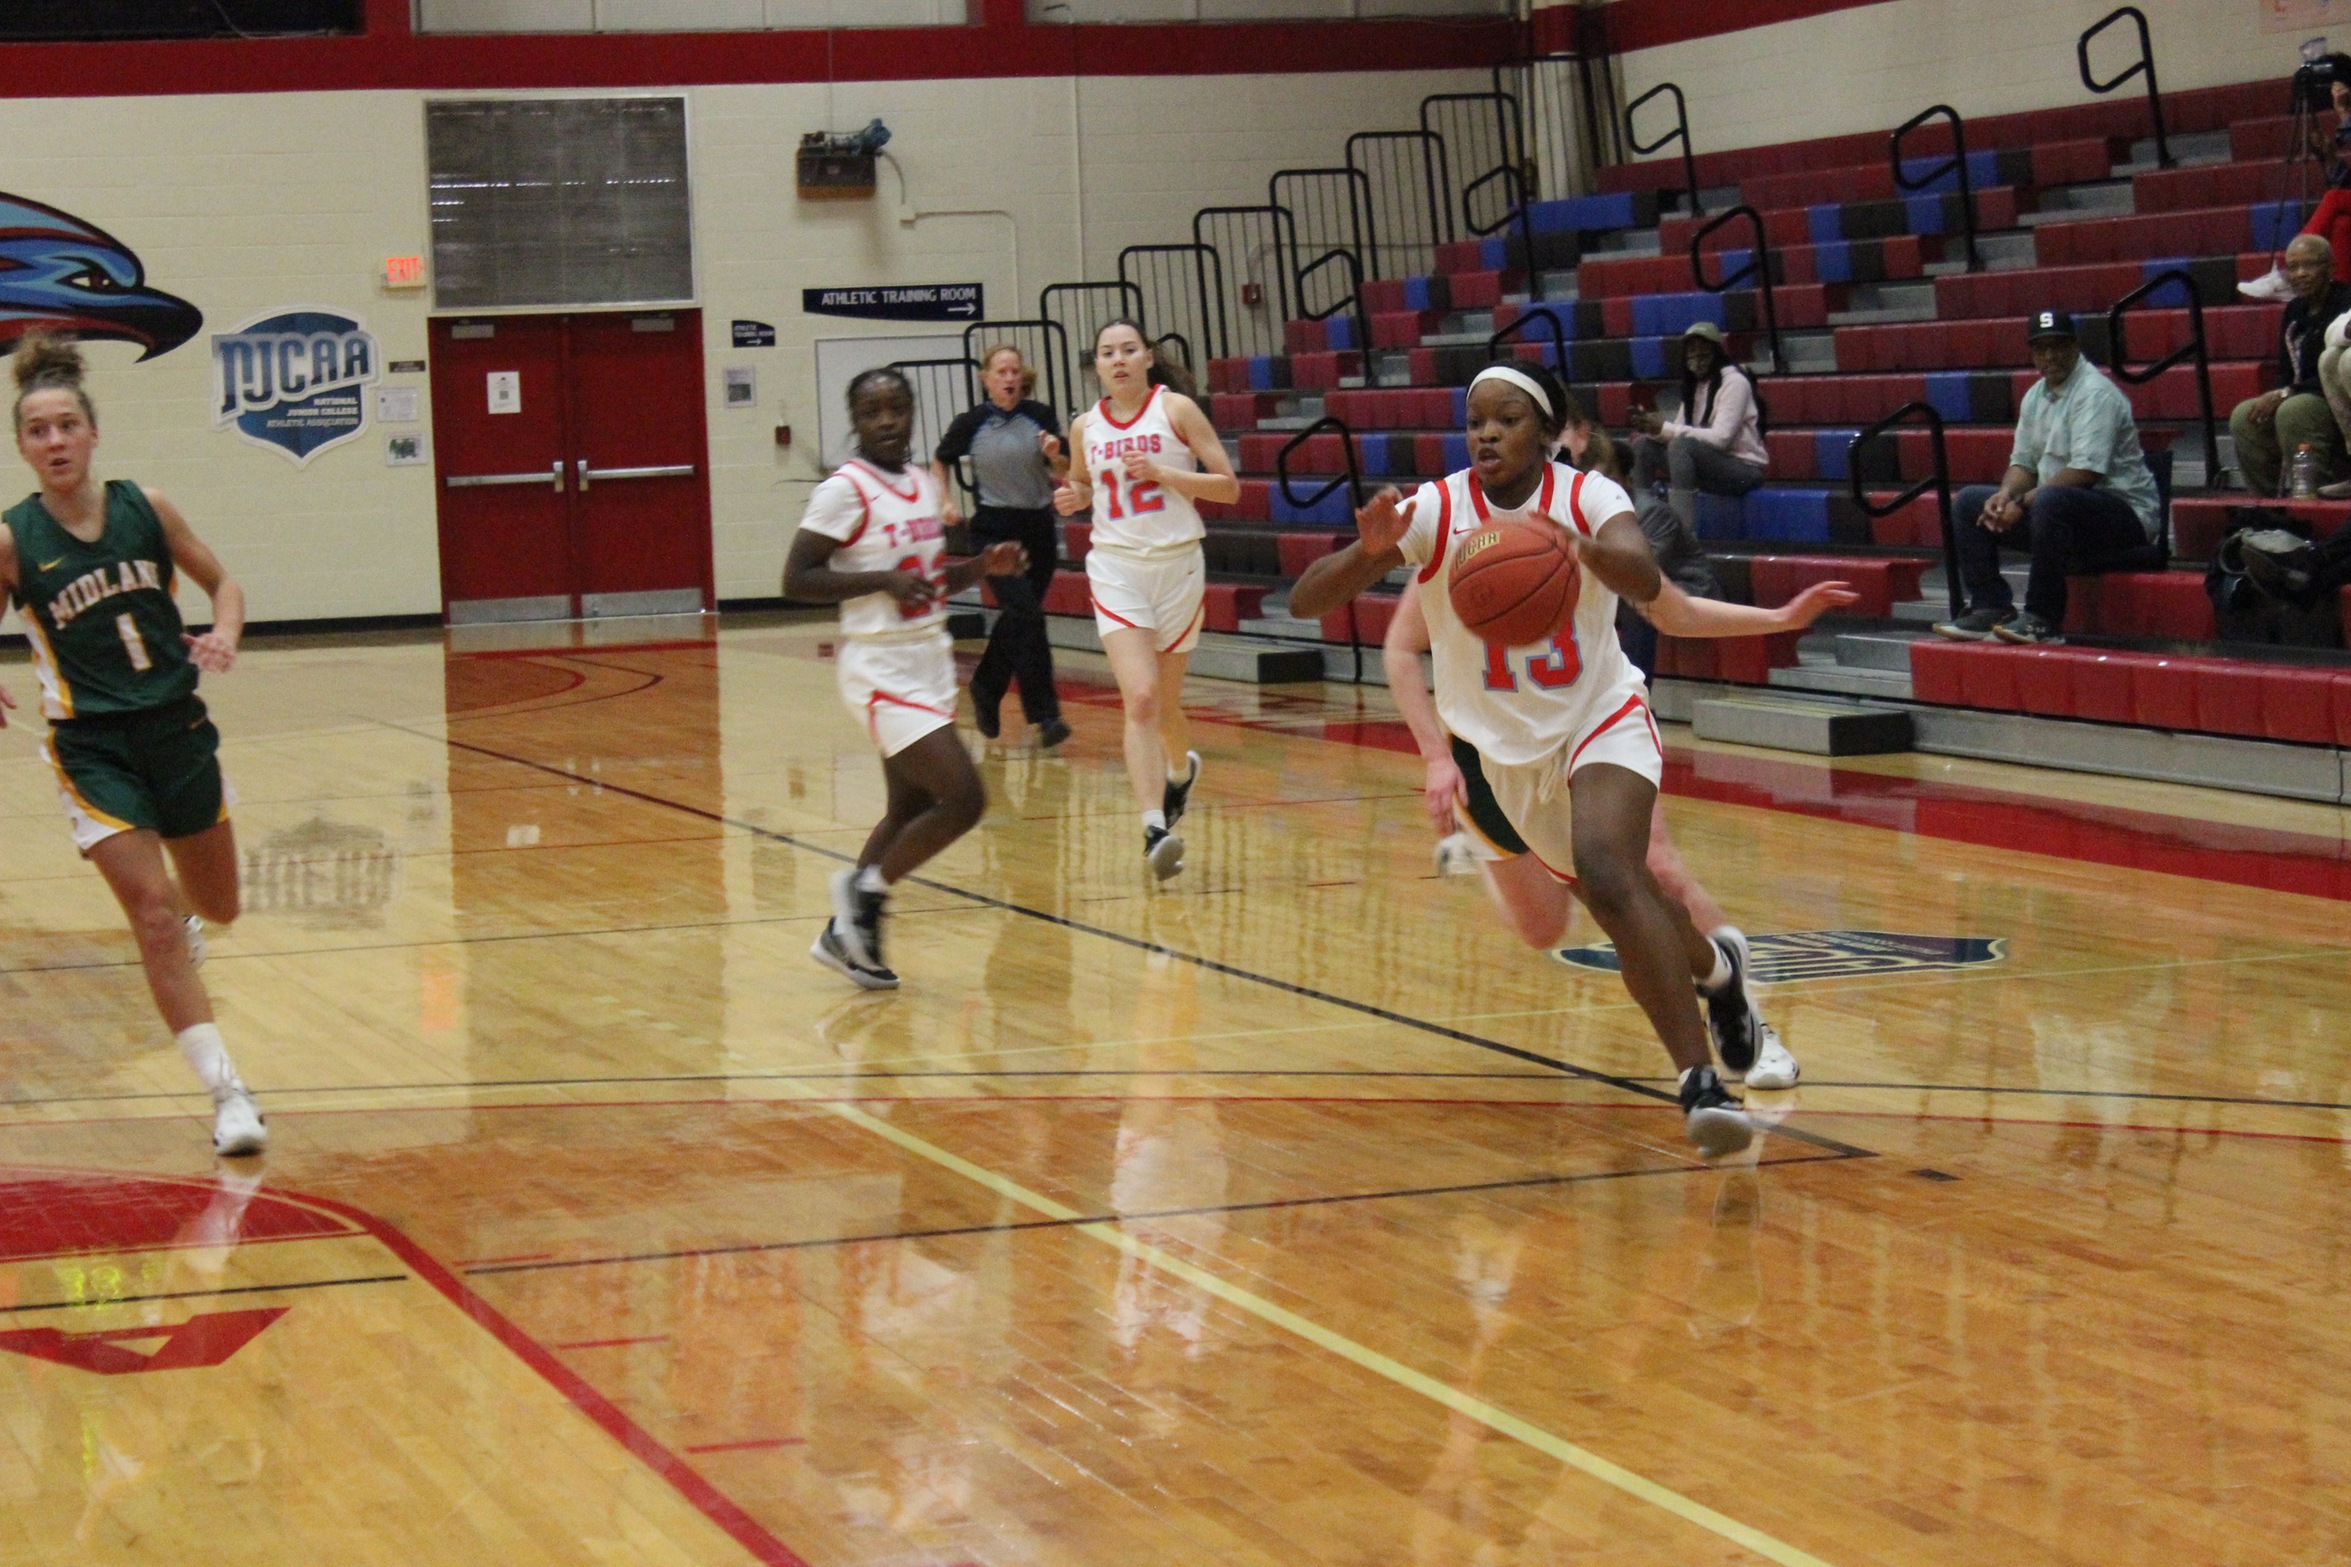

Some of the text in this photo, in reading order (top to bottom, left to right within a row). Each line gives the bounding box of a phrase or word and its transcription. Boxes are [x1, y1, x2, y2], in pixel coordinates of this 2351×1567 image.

[386, 256, 420, 282] EXIT
[821, 287, 977, 306] ATHLETIC TRAINING ROOM
[2039, 312, 2054, 329] S
[217, 336, 370, 415] NJCAA
[1101, 468, 1166, 521] 12
[116, 612, 153, 671] 1
